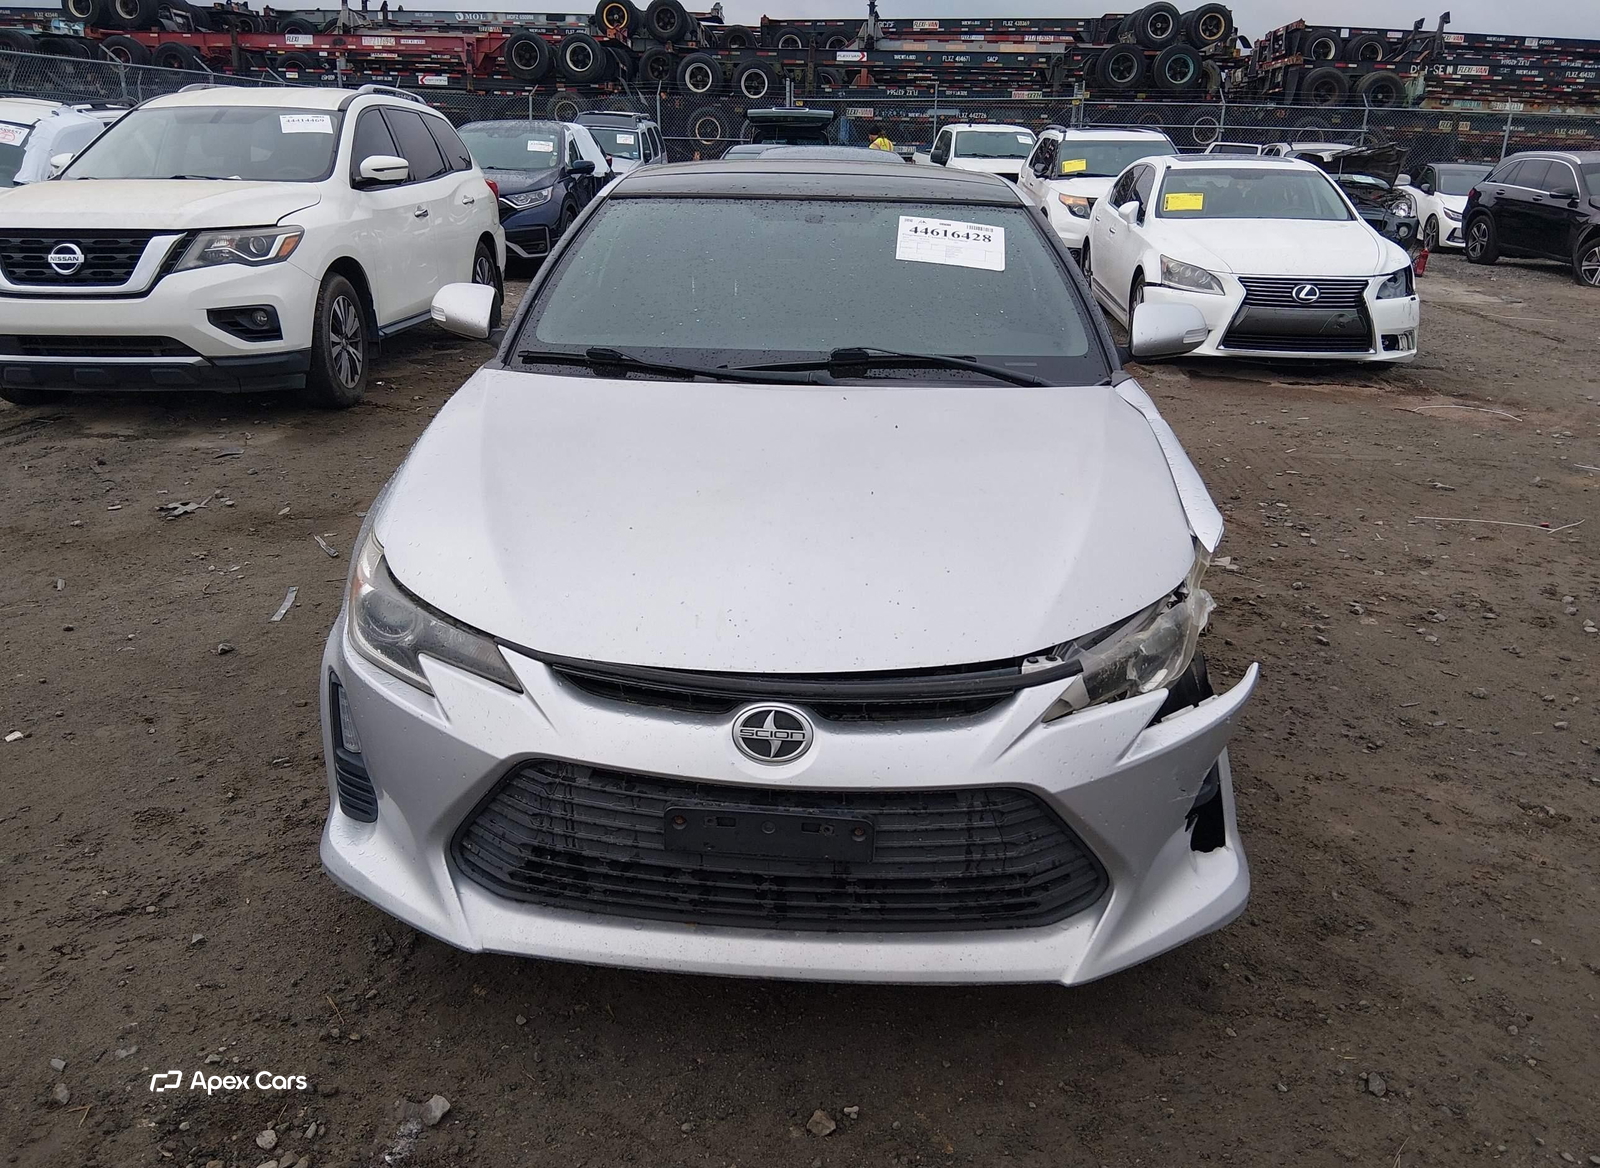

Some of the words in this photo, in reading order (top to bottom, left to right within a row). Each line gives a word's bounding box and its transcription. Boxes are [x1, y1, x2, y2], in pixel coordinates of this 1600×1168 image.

[464, 12, 486, 20] MOL
[1457, 66, 1489, 75] FLEXI-VAN
[909, 226, 992, 243] 44616428
[740, 728, 805, 739] SCION
